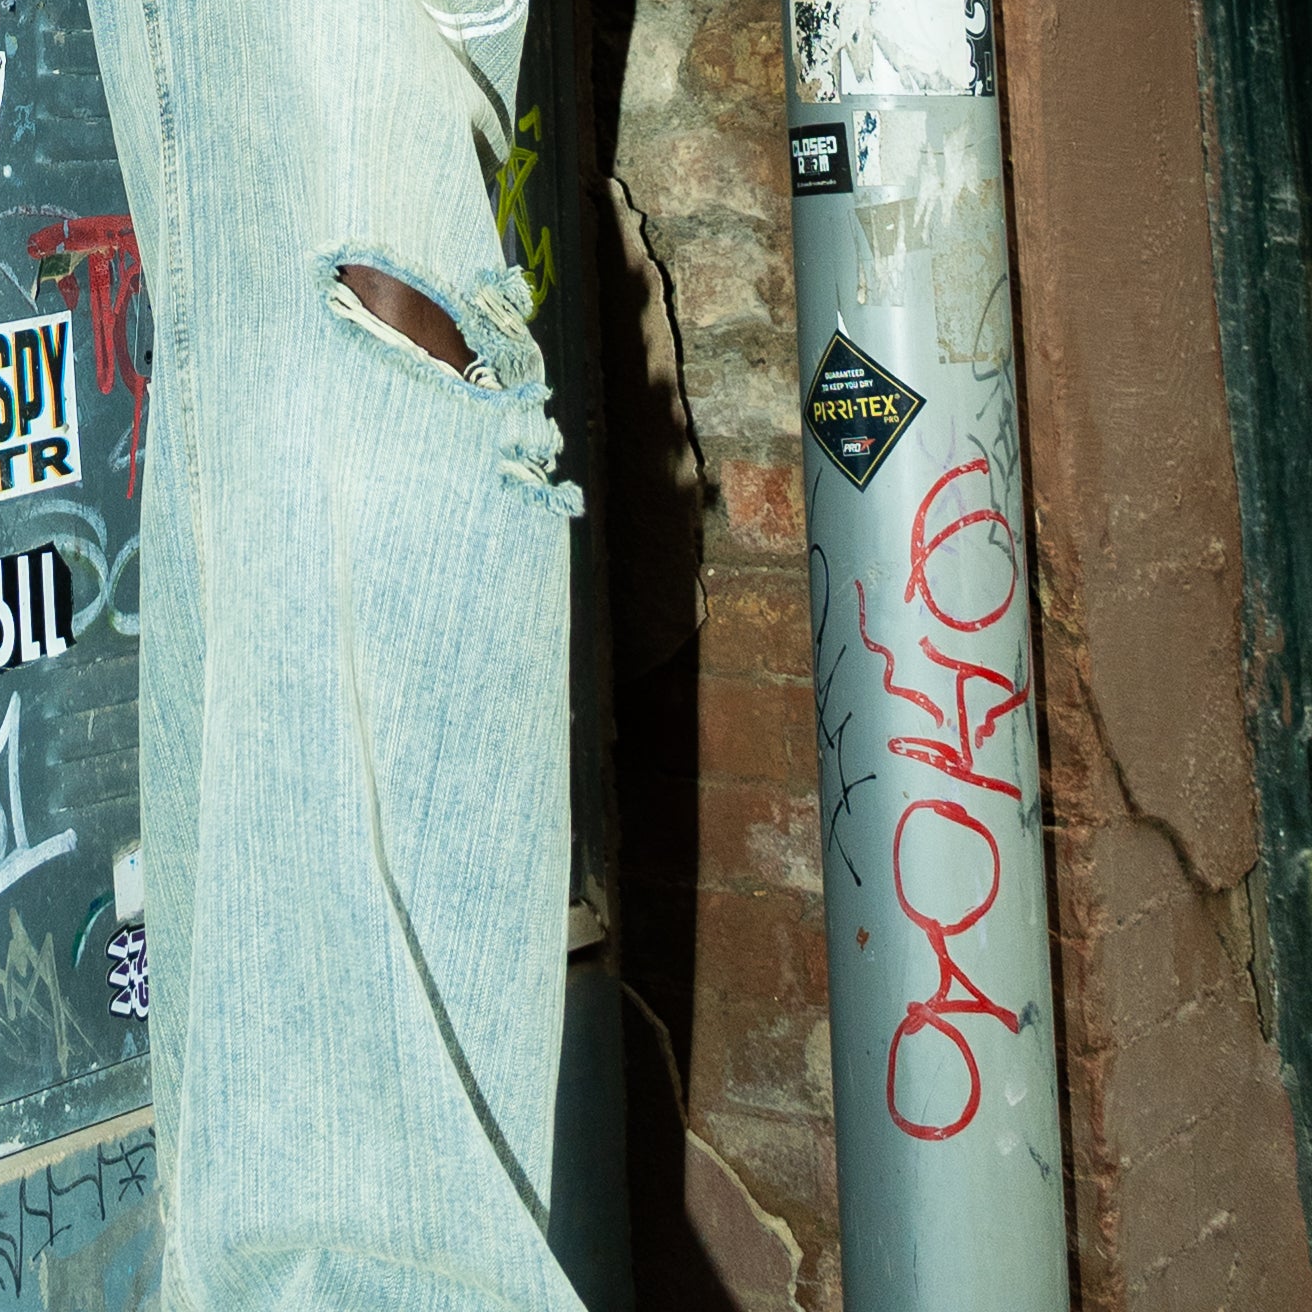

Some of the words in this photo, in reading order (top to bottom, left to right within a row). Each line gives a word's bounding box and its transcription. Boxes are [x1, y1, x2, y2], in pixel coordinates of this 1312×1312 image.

[792, 135, 838, 157] CLOSED
[824, 368, 865, 380] GUARANTEED
[829, 382, 845, 391] KEEP
[845, 381, 859, 390] YOU
[859, 379, 874, 389] DRY
[883, 415, 900, 424] PRO
